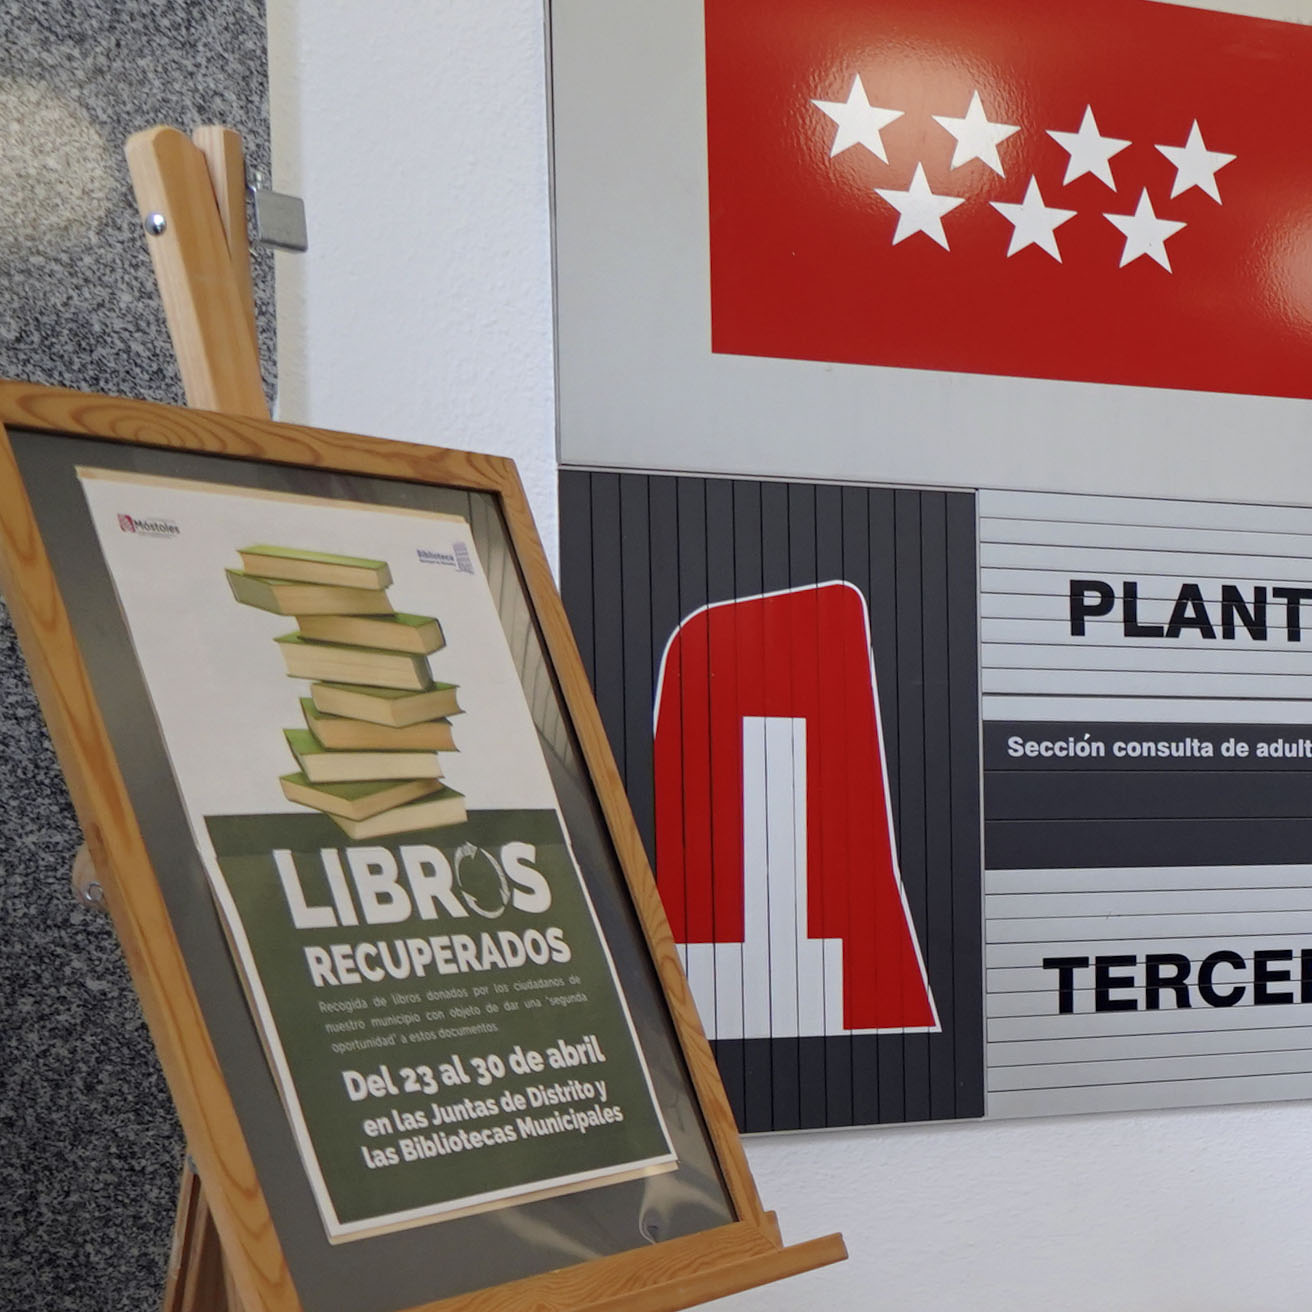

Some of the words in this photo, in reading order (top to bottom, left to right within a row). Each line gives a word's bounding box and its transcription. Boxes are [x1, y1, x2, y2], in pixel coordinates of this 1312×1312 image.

[1007, 733, 1106, 758] Sección
[1112, 737, 1214, 758] consulta
[1221, 738, 1249, 758] de
[272, 840, 552, 929] LIBROS
[304, 926, 571, 987] RECUPERADOS
[319, 999, 368, 1014] Recogida
[373, 996, 387, 1008] de
[391, 992, 421, 1005] libros
[426, 987, 468, 1001] donados
[473, 986, 489, 998] por
[494, 983, 510, 993] los
[513, 977, 564, 992] ciudadanos
[569, 975, 581, 986] de
[325, 1019, 365, 1033] nuestro
[371, 1014, 421, 1030] municipio
[425, 1010, 445, 1022] con
[449, 1005, 481, 1019] objeto
[485, 1002, 499, 1014] de
[504, 999, 519, 1012] dar
[524, 998, 541, 1009] una
[409, 1031, 437, 1044] estos
[342, 1065, 399, 1101] Del
[399, 1065, 439, 1094] 23
[438, 1054, 471, 1086] al
[470, 1054, 506, 1086] 30
[509, 1046, 545, 1075] de
[545, 1035, 606, 1069] abril
[361, 1146, 400, 1169] las
[398, 1124, 518, 1162] Bibliotecas
[516, 1104, 624, 1138] Municipales
[363, 1116, 393, 1137] en
[392, 1109, 429, 1132] las
[431, 1097, 499, 1126] Juntas
[499, 1091, 527, 1112] de
[525, 1080, 595, 1108] Distrito
[593, 1080, 607, 1102] y
